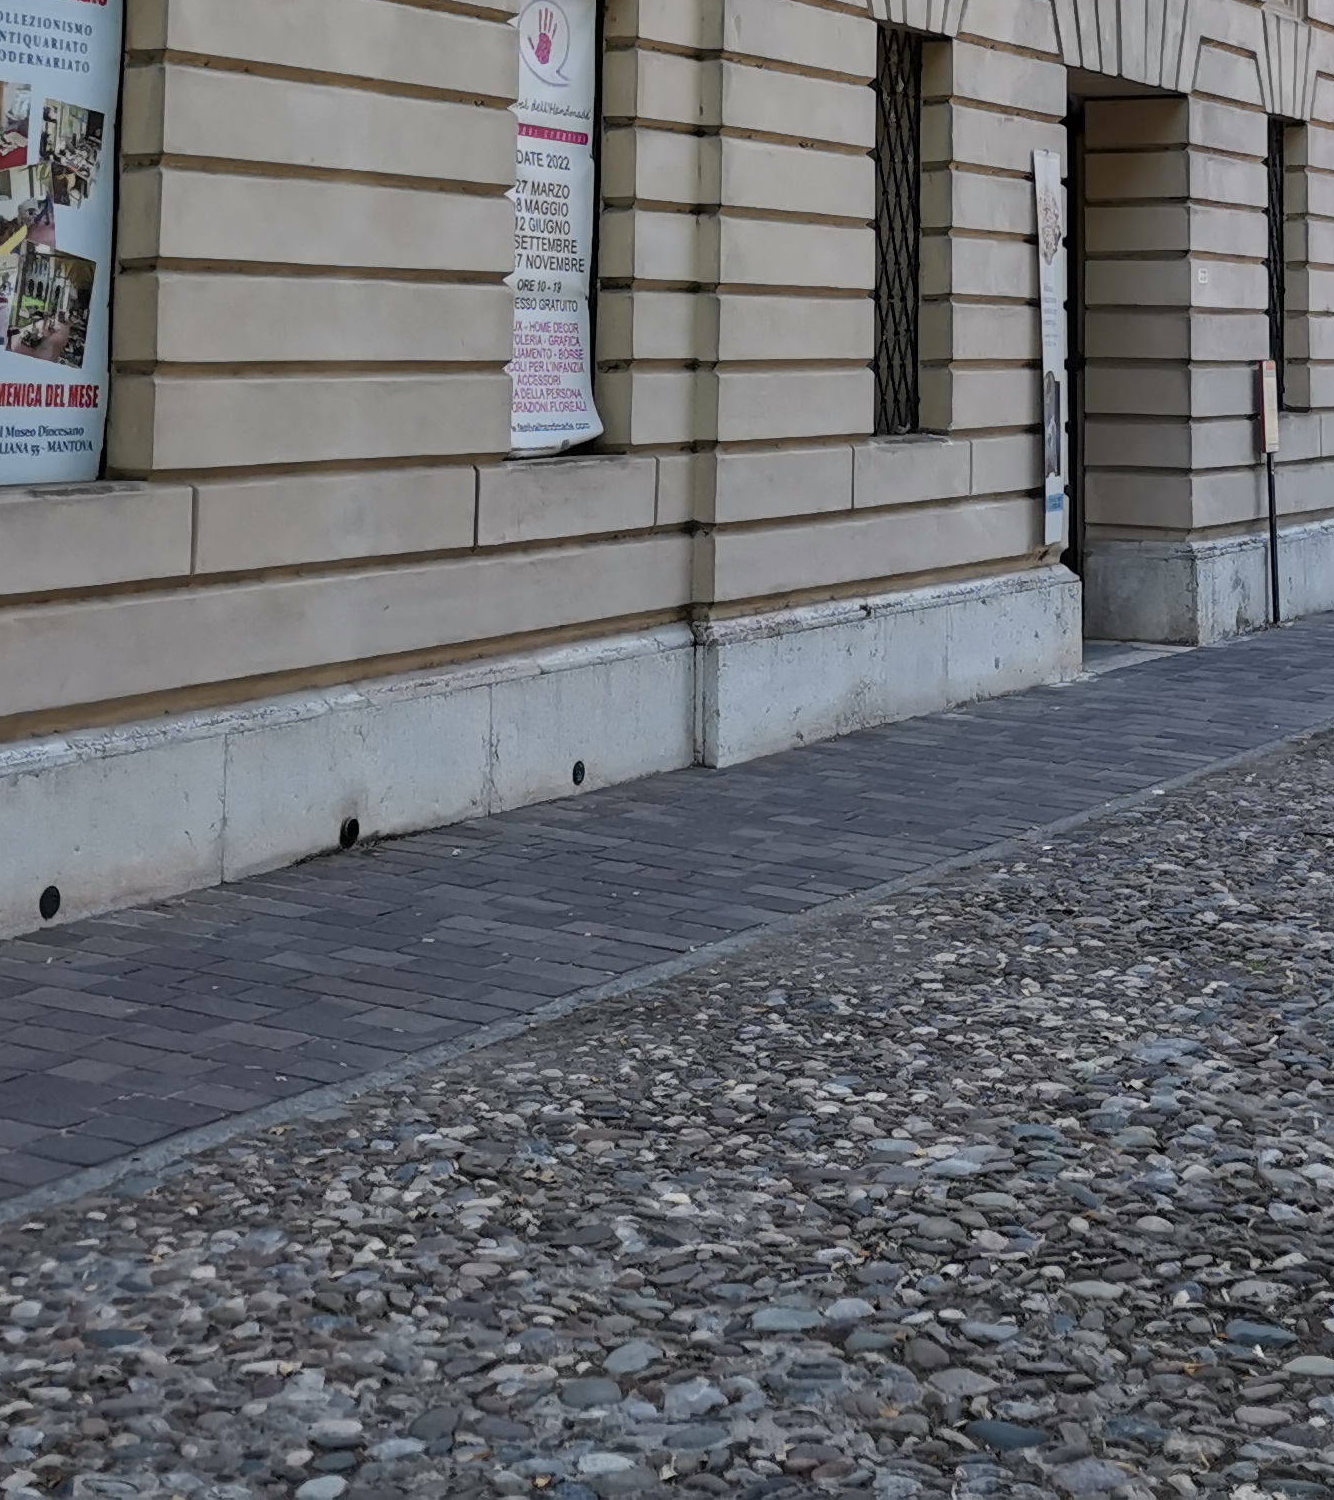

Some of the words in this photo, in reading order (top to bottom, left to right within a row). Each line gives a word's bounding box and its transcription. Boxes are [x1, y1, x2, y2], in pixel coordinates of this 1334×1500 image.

[516, 150, 544, 167] DATE
[546, 153, 570, 171] 2022
[515, 179, 528, 194] 27
[530, 181, 570, 199] MARZO
[525, 199, 569, 217] MAGGIO
[515, 216, 526, 231] 12
[528, 217, 570, 235] GIUGNO
[514, 234, 578, 254] SETTEMBRE
[526, 254, 585, 273] NOVEMBRE
[517, 279, 535, 291] ORE
[537, 281, 546, 292] 10
[539, 299, 578, 312] GRATUITO
[529, 321, 551, 333] HOME
[553, 321, 579, 334] DECOR
[548, 335, 581, 347] GRAFICA
[558, 349, 584, 360] BORSE
[529, 361, 544, 372] PER
[517, 374, 561, 386] ACCESSORI
[45, 383, 65, 408] DEL
[68, 384, 100, 408] MESE
[520, 388, 545, 399] DELLA
[546, 388, 583, 399] PERSONA
[5, 425, 36, 438] Museo
[38, 425, 84, 437] Diocesano
[47, 440, 93, 453] MANTOVA
